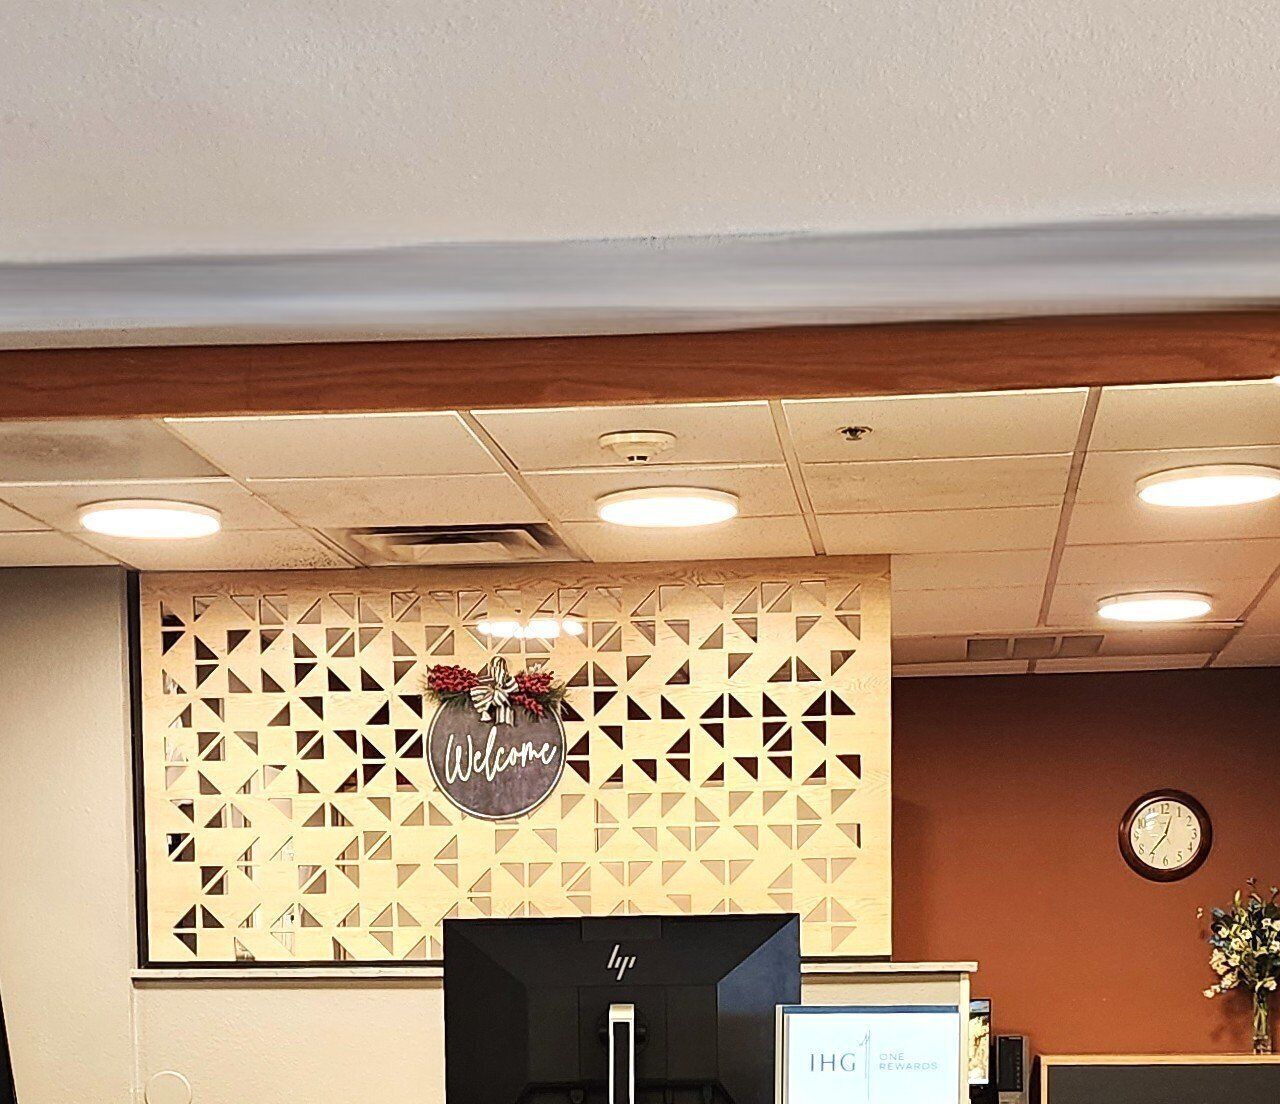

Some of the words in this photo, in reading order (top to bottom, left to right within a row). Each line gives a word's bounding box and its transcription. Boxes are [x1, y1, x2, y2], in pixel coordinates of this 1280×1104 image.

[445, 726, 558, 784] Welcome
[1160, 803, 1170, 814] 12
[1186, 815, 1192, 827] 2
[1163, 855, 1169, 866] 6
[1176, 851, 1182, 862] 5
[607, 944, 636, 981] hp
[810, 1052, 856, 1073] IHG
[879, 1052, 905, 1062] ONE
[878, 1062, 938, 1071] REWARDS
